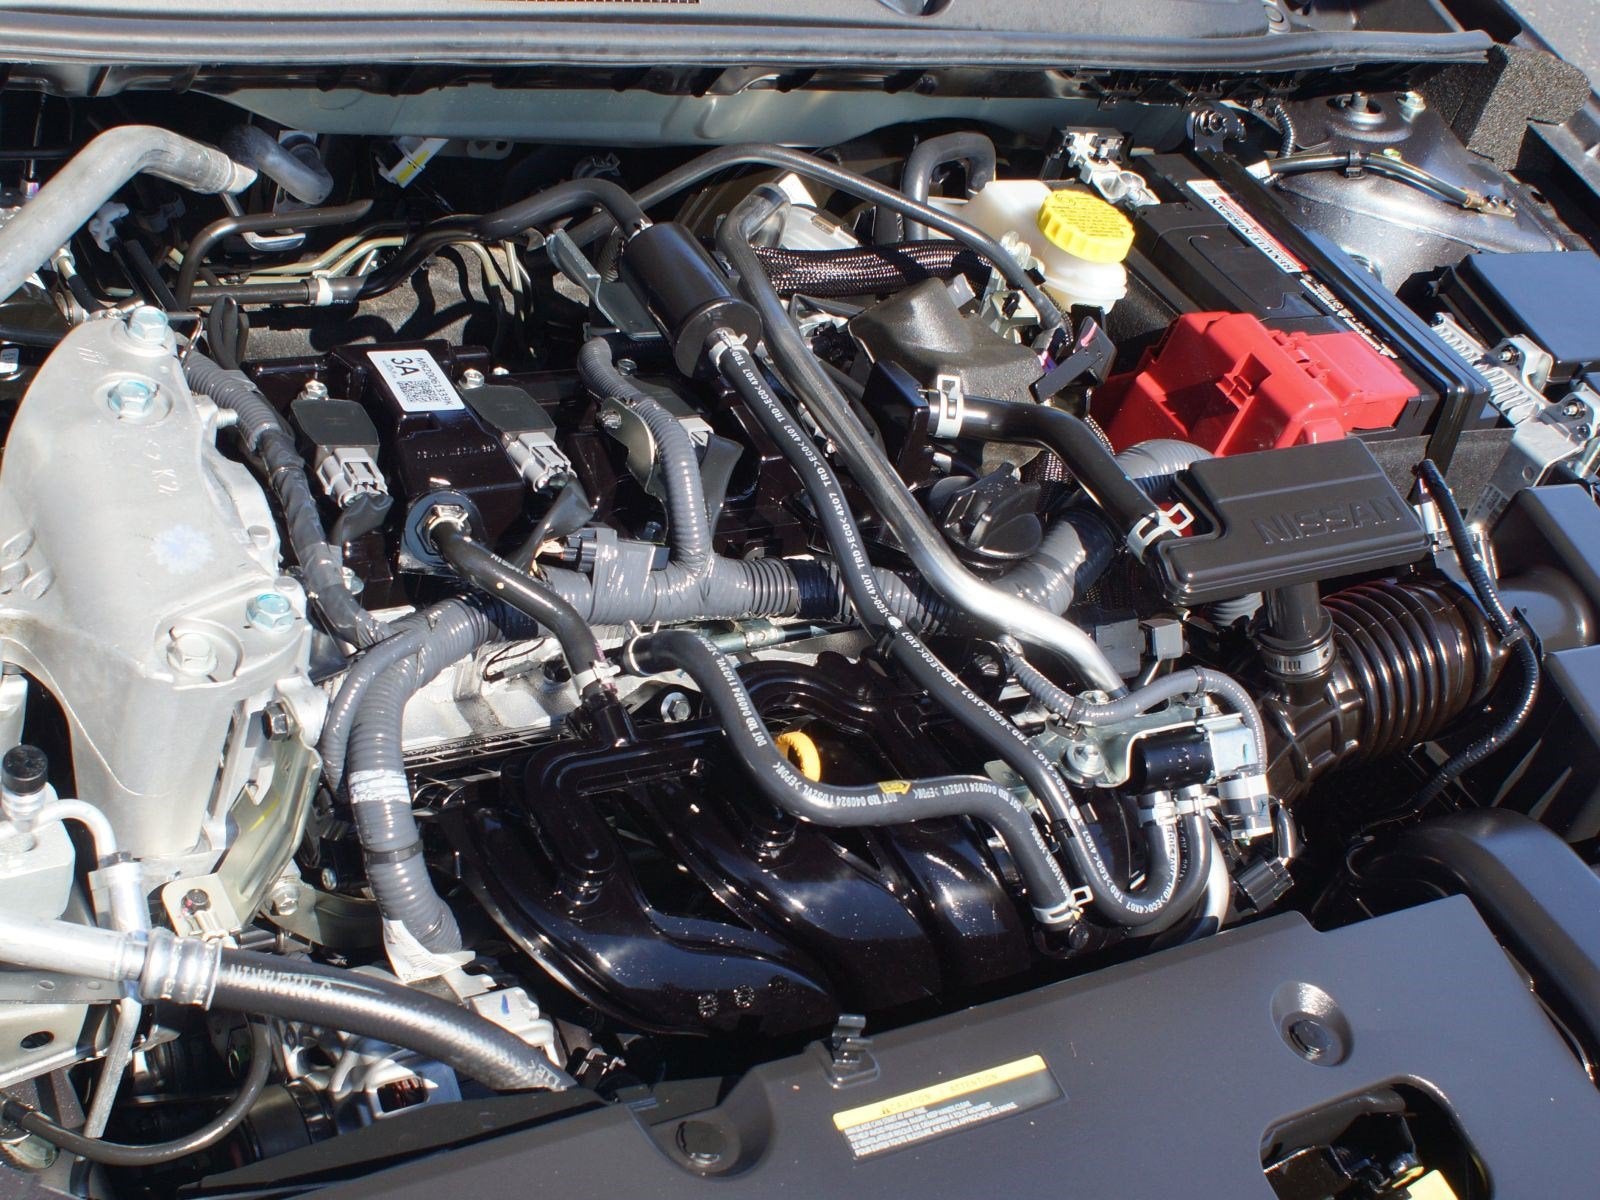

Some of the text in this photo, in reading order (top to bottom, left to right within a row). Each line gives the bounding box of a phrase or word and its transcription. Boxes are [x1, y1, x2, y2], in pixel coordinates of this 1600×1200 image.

[1208, 198, 1253, 235] NISSAN
[391, 357, 420, 376] 3A
[743, 368, 786, 423] TRD>ECO<4X07
[783, 424, 832, 488] TRD>ECO<4X07
[829, 491, 865, 570] TRD>ECO<4X07
[1252, 496, 1402, 545] NISSAN
[901, 631, 959, 688] TRD>ECO<4X07
[752, 731, 768, 747] DOT
[961, 689, 1030, 746] TRD>ECO<4X07
